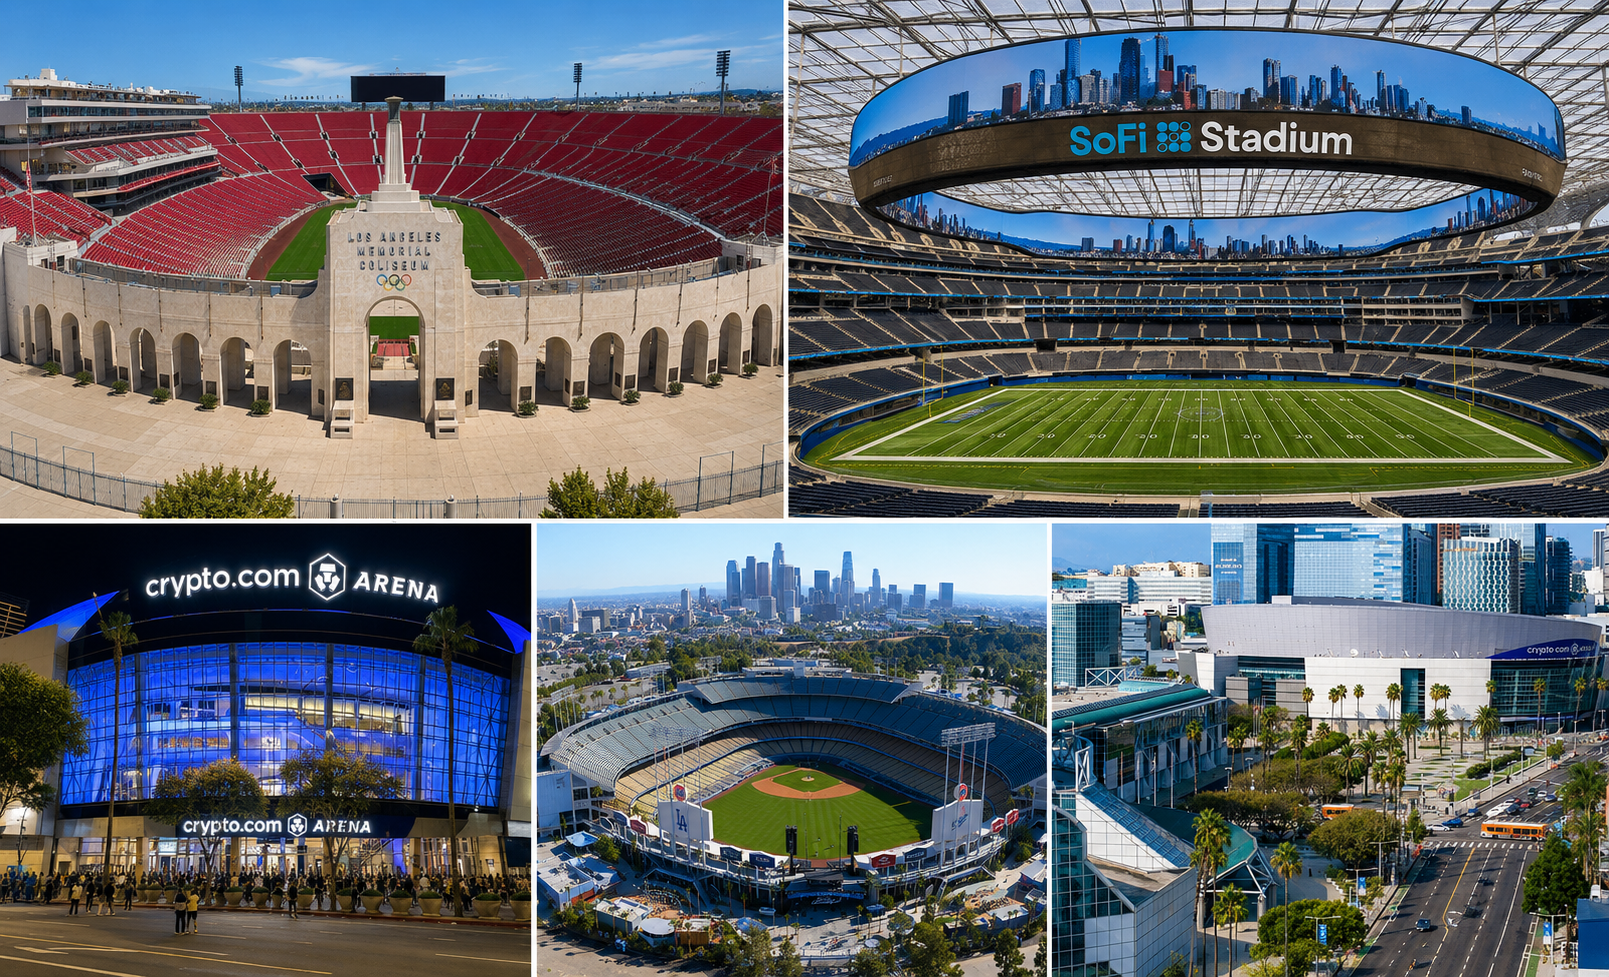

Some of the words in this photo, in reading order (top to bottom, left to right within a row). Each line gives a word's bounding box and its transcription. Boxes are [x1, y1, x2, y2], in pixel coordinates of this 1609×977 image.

[1069, 121, 1148, 157] SoFi
[1200, 120, 1353, 156] Stadium
[348, 232, 371, 243] LOS
[380, 232, 441, 243] ANGELES
[357, 246, 431, 257] MEMORIAL
[359, 260, 429, 271] COLISEUM
[145, 567, 301, 599] crypto.com
[353, 570, 440, 604] ARENA
[182, 817, 282, 837] crypto.com
[312, 818, 372, 834] ARENA
[675, 808, 688, 833] LA
